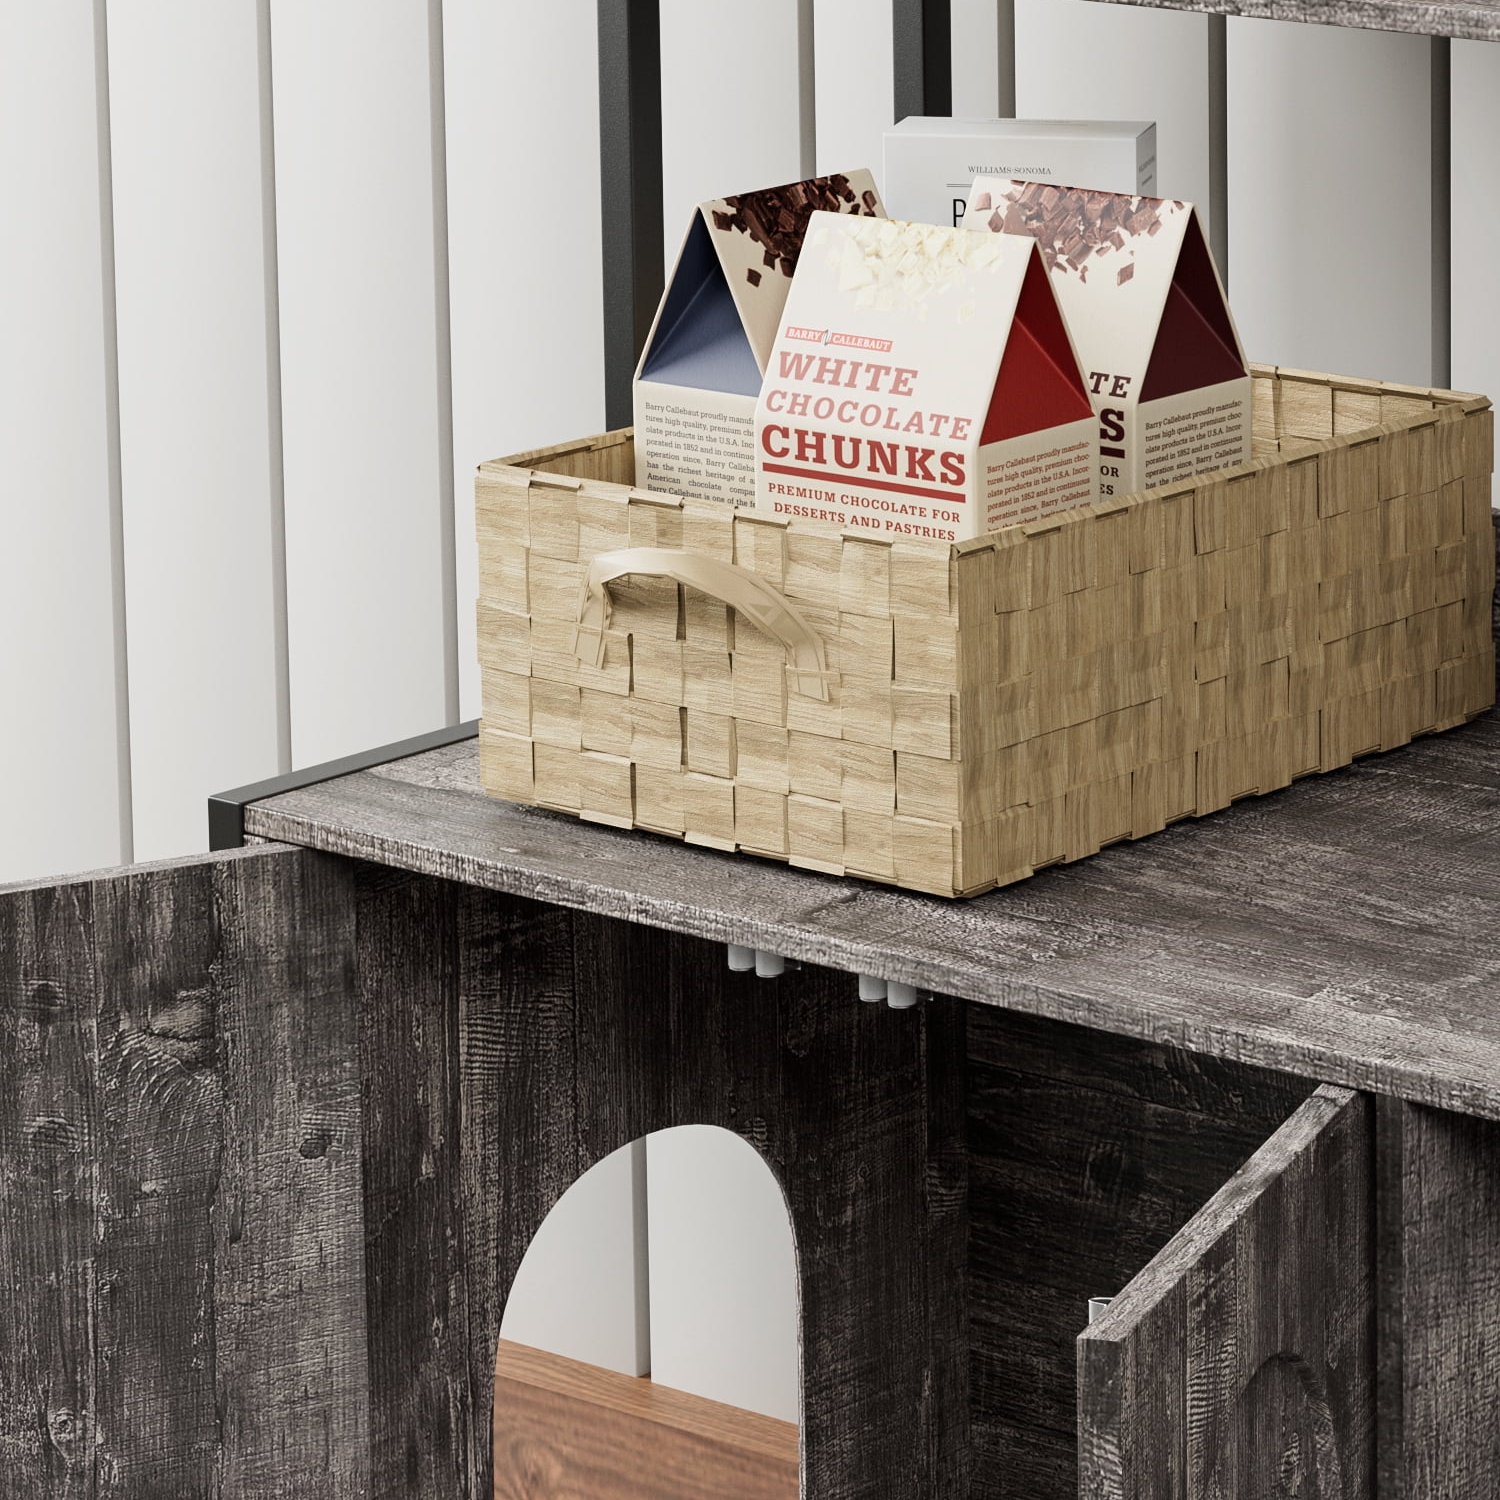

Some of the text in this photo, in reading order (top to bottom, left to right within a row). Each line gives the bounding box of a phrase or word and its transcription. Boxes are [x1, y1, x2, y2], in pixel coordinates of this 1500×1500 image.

[788, 328, 891, 350] BARRY CALLEBAUT
[779, 351, 919, 397] WHITE
[646, 402, 664, 413] Barry
[666, 405, 699, 417] Callebaut
[701, 412, 727, 422] proudly
[766, 389, 972, 441] CHOCOLATE
[1145, 421, 1162, 430] Barry
[1163, 412, 1191, 426] Callebaut
[1193, 405, 1215, 419] proudly
[646, 415, 663, 423] tures
[665, 417, 680, 427] high
[682, 421, 708, 431] quality,
[710, 425, 741, 436] premium
[646, 426, 663, 434] olate
[665, 430, 695, 440] products
[719, 437, 739, 446] U.S.A.
[1146, 433, 1160, 442] tures
[1162, 427, 1176, 437] high
[1177, 423, 1198, 435] quality,
[1200, 416, 1226, 429] premium
[646, 439, 672, 448] porated
[675, 441, 681, 449] in
[684, 443, 698, 451] 1852
[700, 446, 713, 454] and
[1146, 445, 1160, 454] olate
[1162, 437, 1188, 452] products
[1197, 431, 1206, 440] the
[1146, 454, 1169, 467] porated
[1170, 452, 1176, 460] in
[1191, 445, 1202, 454] and
[1203, 442, 1209, 450] in
[1211, 435, 1242, 449] continuous
[647, 450, 679, 460] operation
[683, 455, 702, 465] since,
[706, 458, 725, 469] Barry
[761, 424, 966, 486] CHUNKS
[987, 463, 1004, 474] Barry
[1006, 455, 1035, 468] Callebaut
[1037, 449, 1060, 462] proudly
[1146, 447, 1242, 478] operation since, Barry Callebaut
[647, 461, 659, 469] has
[663, 463, 674, 471] the
[678, 467, 701, 475] richest
[706, 470, 735, 481] heritage
[739, 476, 745, 484] of
[647, 472, 681, 484] American
[688, 479, 721, 490] chocolate
[987, 477, 1003, 486] tures
[1005, 471, 1019, 482] high
[1021, 465, 1043, 478] quality,
[1045, 459, 1072, 472] premium
[1100, 465, 1120, 478] OR
[1159, 476, 1169, 485] the
[647, 484, 666, 494] Barry
[669, 487, 702, 499] Callebaut
[727, 496, 733, 504] of
[736, 498, 748, 507] the
[987, 490, 1003, 498] olate
[1005, 482, 1032, 495] products
[1041, 475, 1051, 483] the
[988, 498, 1012, 512] porated
[1014, 496, 1019, 504] in
[1021, 492, 1035, 501] 1852
[1036, 488, 1048, 497] and
[1056, 477, 1090, 492] continuous
[768, 482, 961, 523] PREMIUM CHOCOLATE FOR
[988, 511, 1018, 524] operation
[1021, 505, 1038, 513] since,
[1041, 498, 1058, 510] Barry
[1061, 490, 1090, 502] Callebaut
[773, 502, 955, 541] DESSERTS AND PASTRIES
